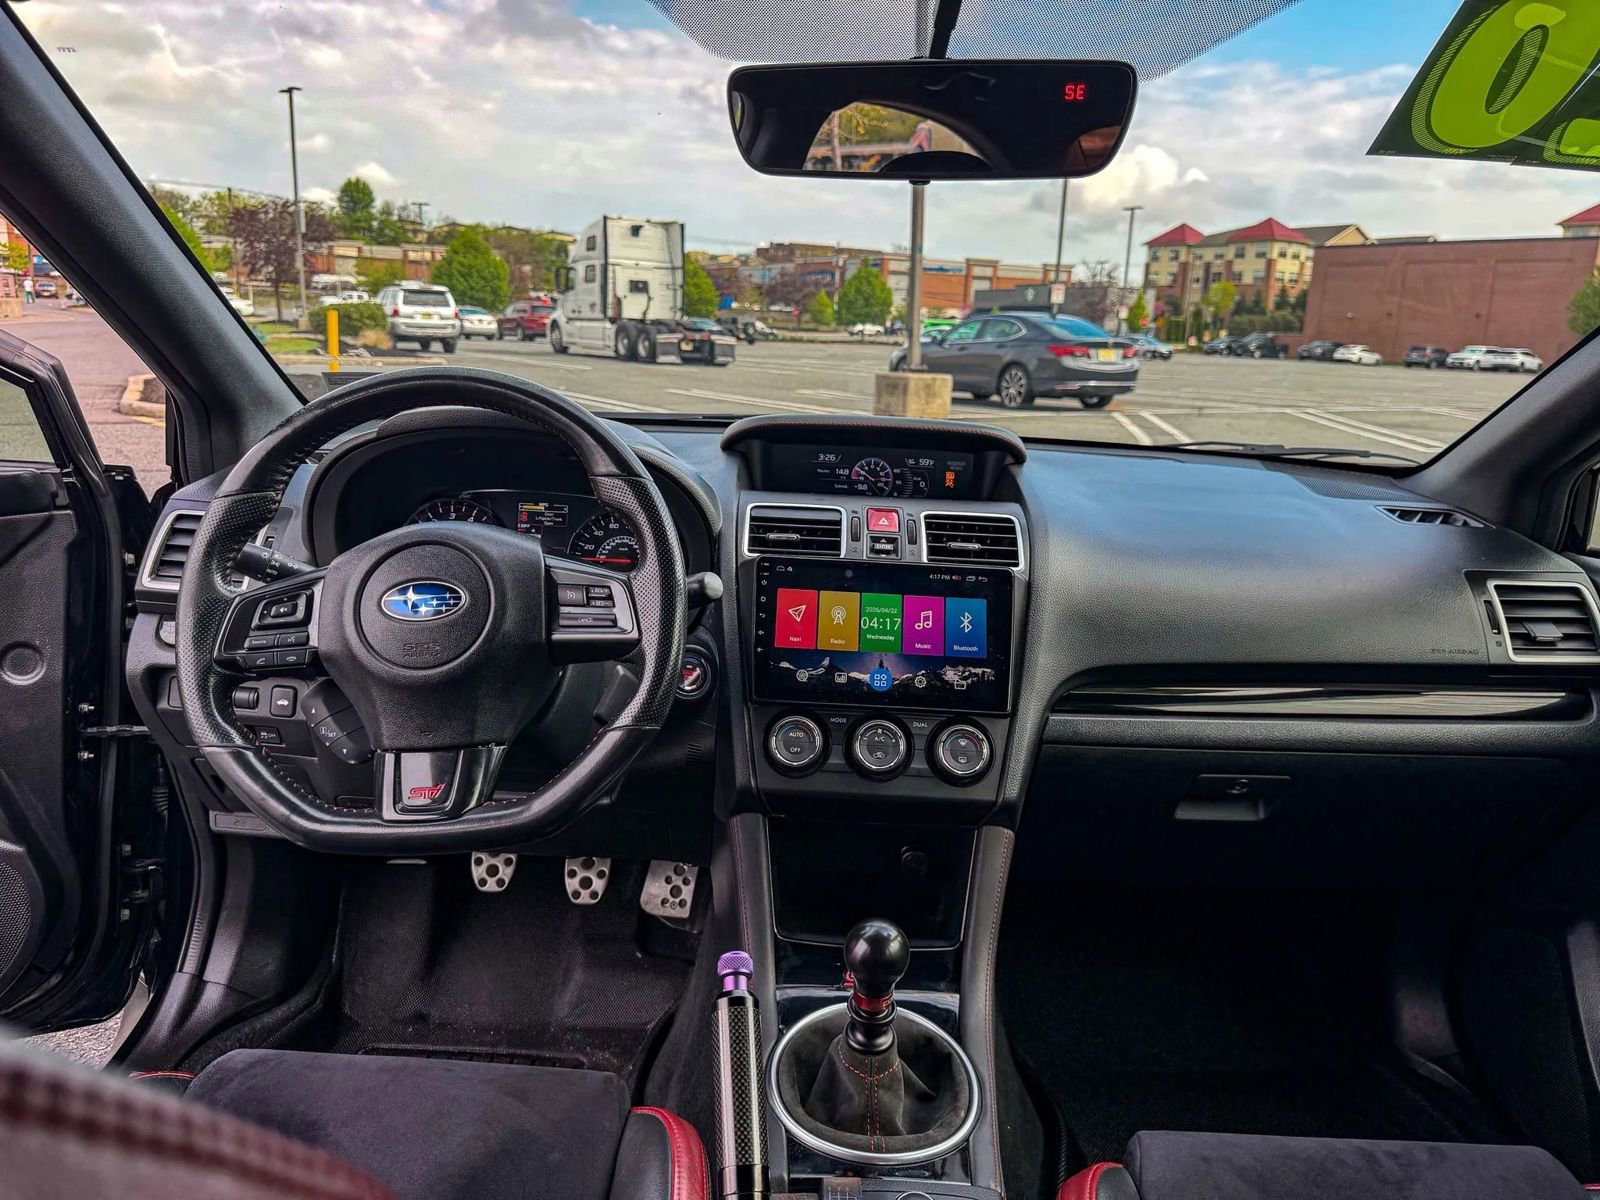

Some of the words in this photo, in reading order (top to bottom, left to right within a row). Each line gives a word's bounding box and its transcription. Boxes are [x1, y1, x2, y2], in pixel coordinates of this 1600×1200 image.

[1065, 85, 1085, 100] SE
[818, 453, 836, 461] 3:26
[448, 512, 456, 520] 3
[861, 616, 901, 630] 04:17
